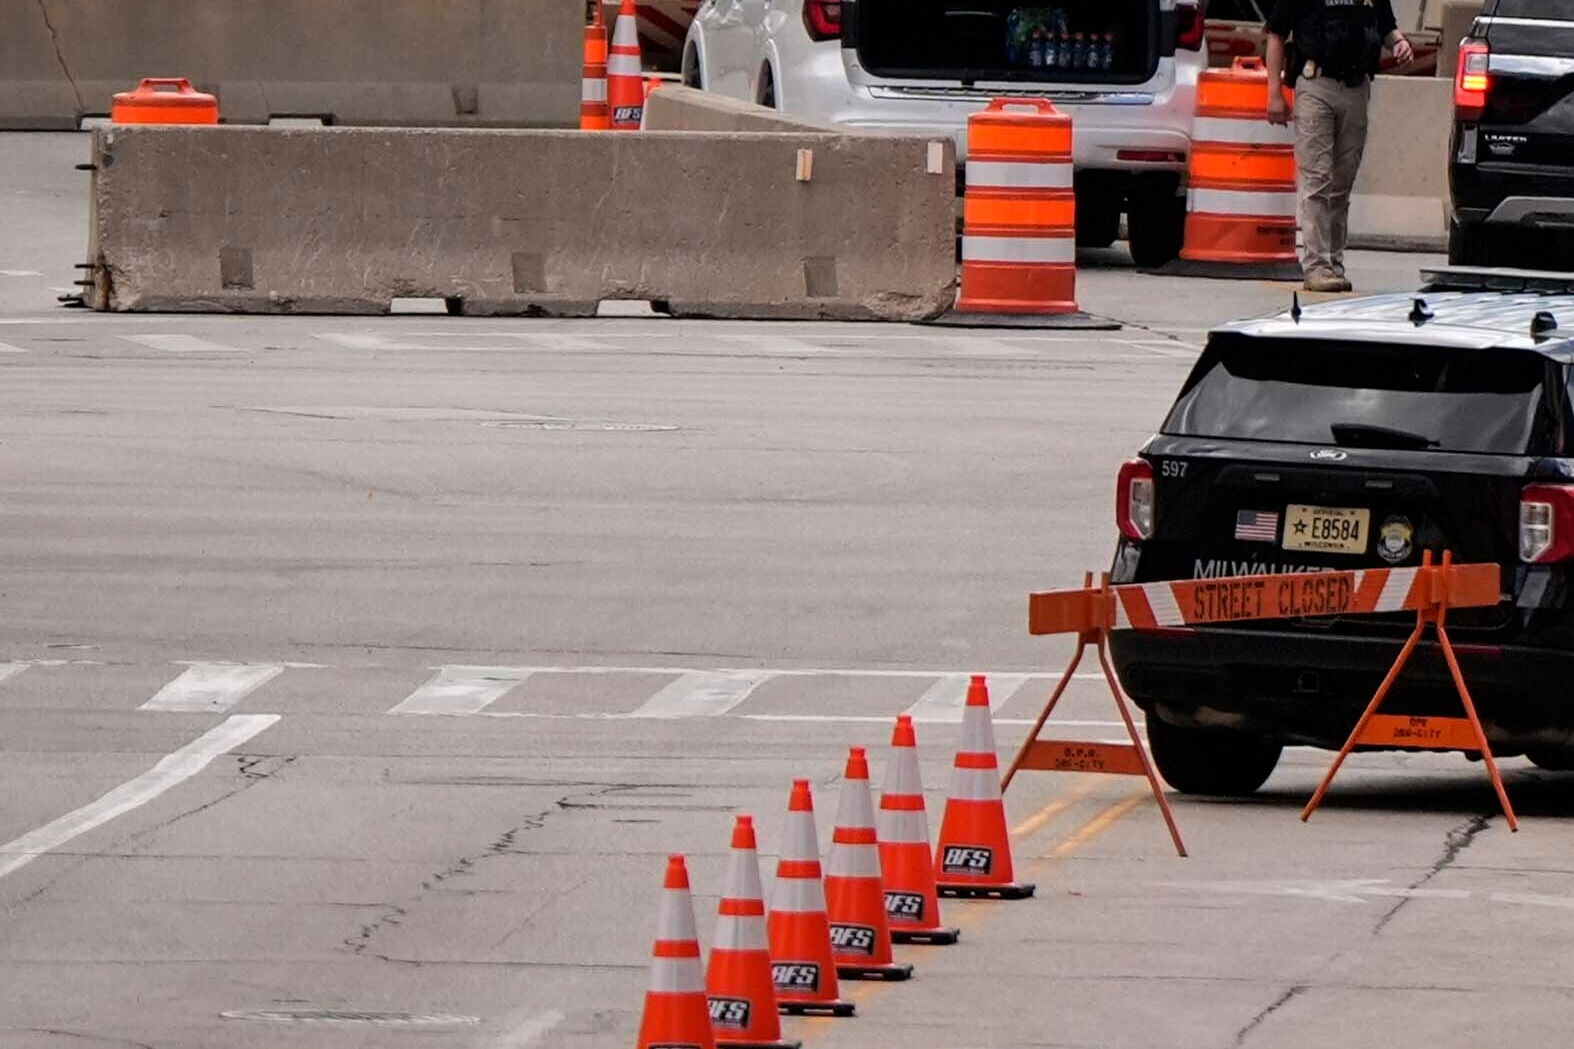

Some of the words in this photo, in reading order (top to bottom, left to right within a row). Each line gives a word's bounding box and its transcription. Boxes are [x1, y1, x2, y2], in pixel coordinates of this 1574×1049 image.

[1161, 460, 1188, 478] 597
[1312, 517, 1360, 542] E8584
[1193, 558, 1337, 581] MILWA
[1193, 579, 1265, 620] STREET
[1279, 575, 1350, 615] CLOSED
[944, 848, 990, 868] BFS
